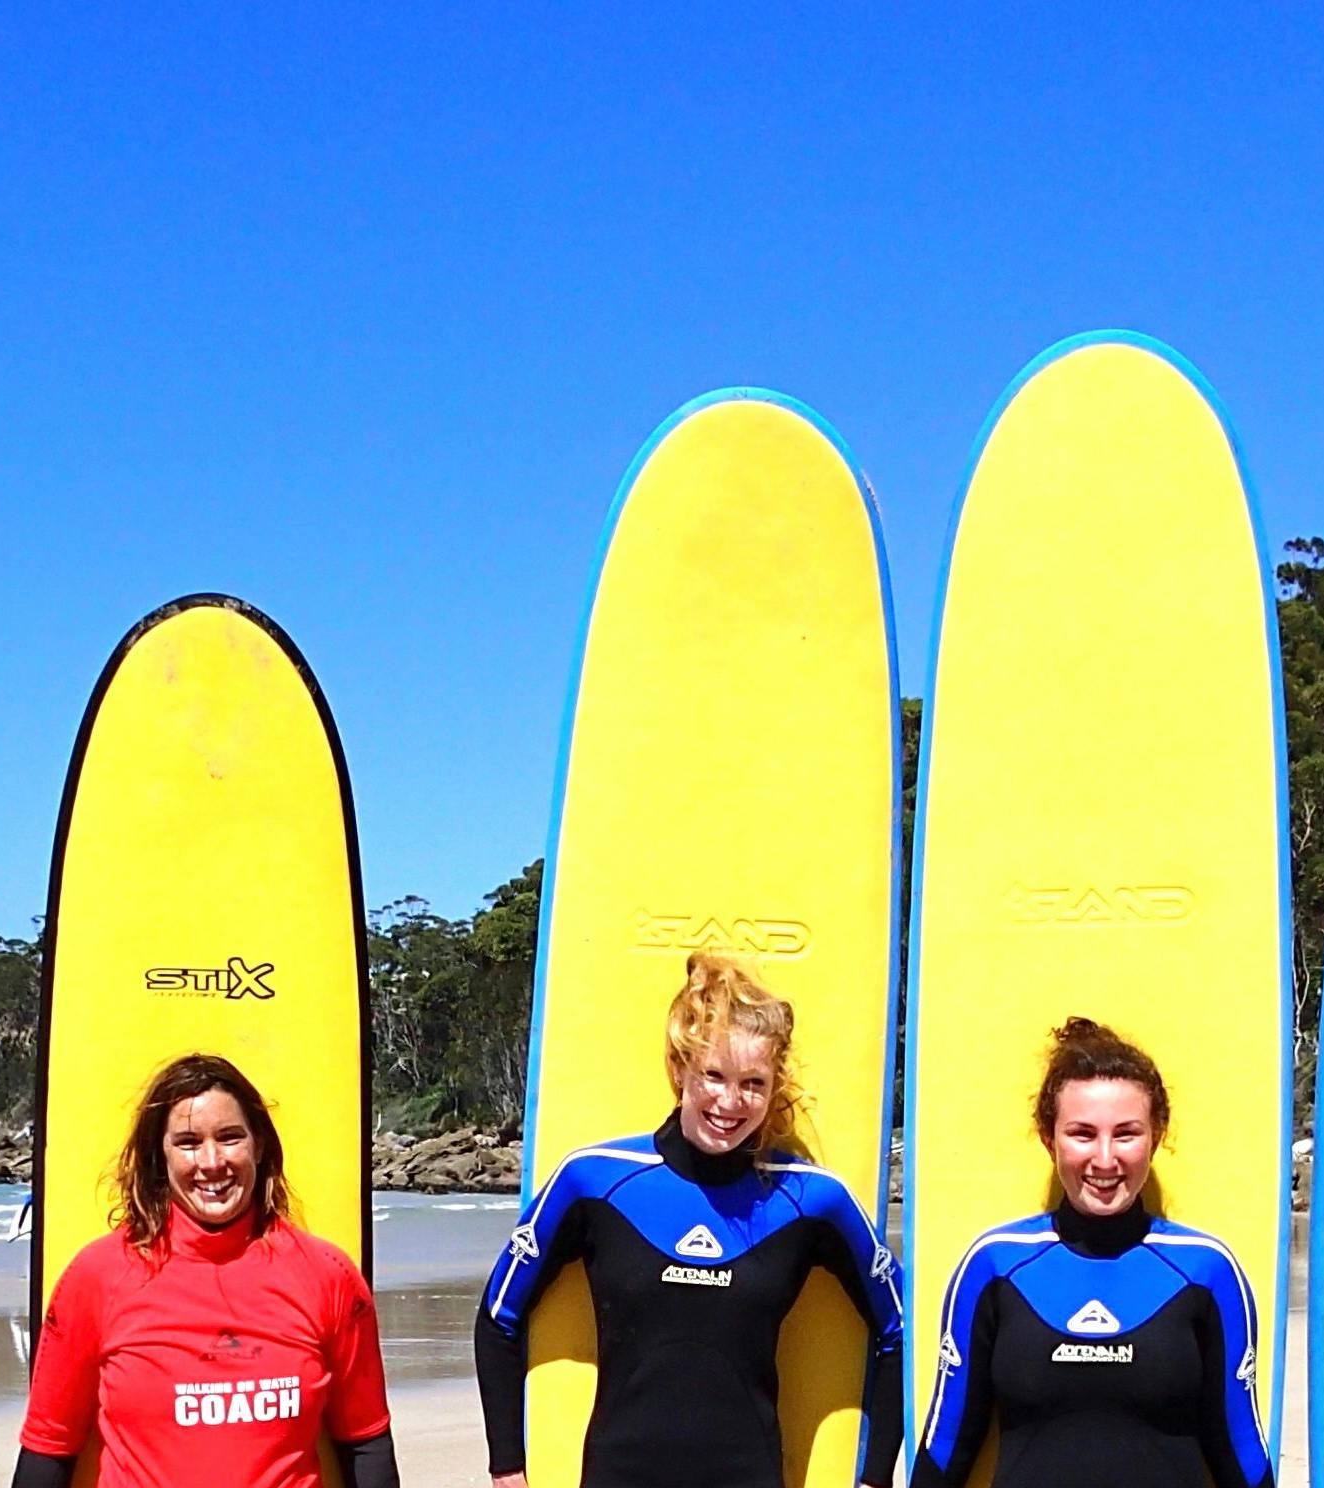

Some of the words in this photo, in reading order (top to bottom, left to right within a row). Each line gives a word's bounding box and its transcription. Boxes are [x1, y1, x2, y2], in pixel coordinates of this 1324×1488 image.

[144, 956, 276, 1000] STIX
[662, 1264, 733, 1280] ADRENALIN
[1052, 1343, 1134, 1357] ADRENALIN
[174, 1382, 233, 1395] WALKING
[236, 1380, 256, 1393] ON
[258, 1375, 300, 1391] WATER
[174, 1388, 301, 1427] COACH
